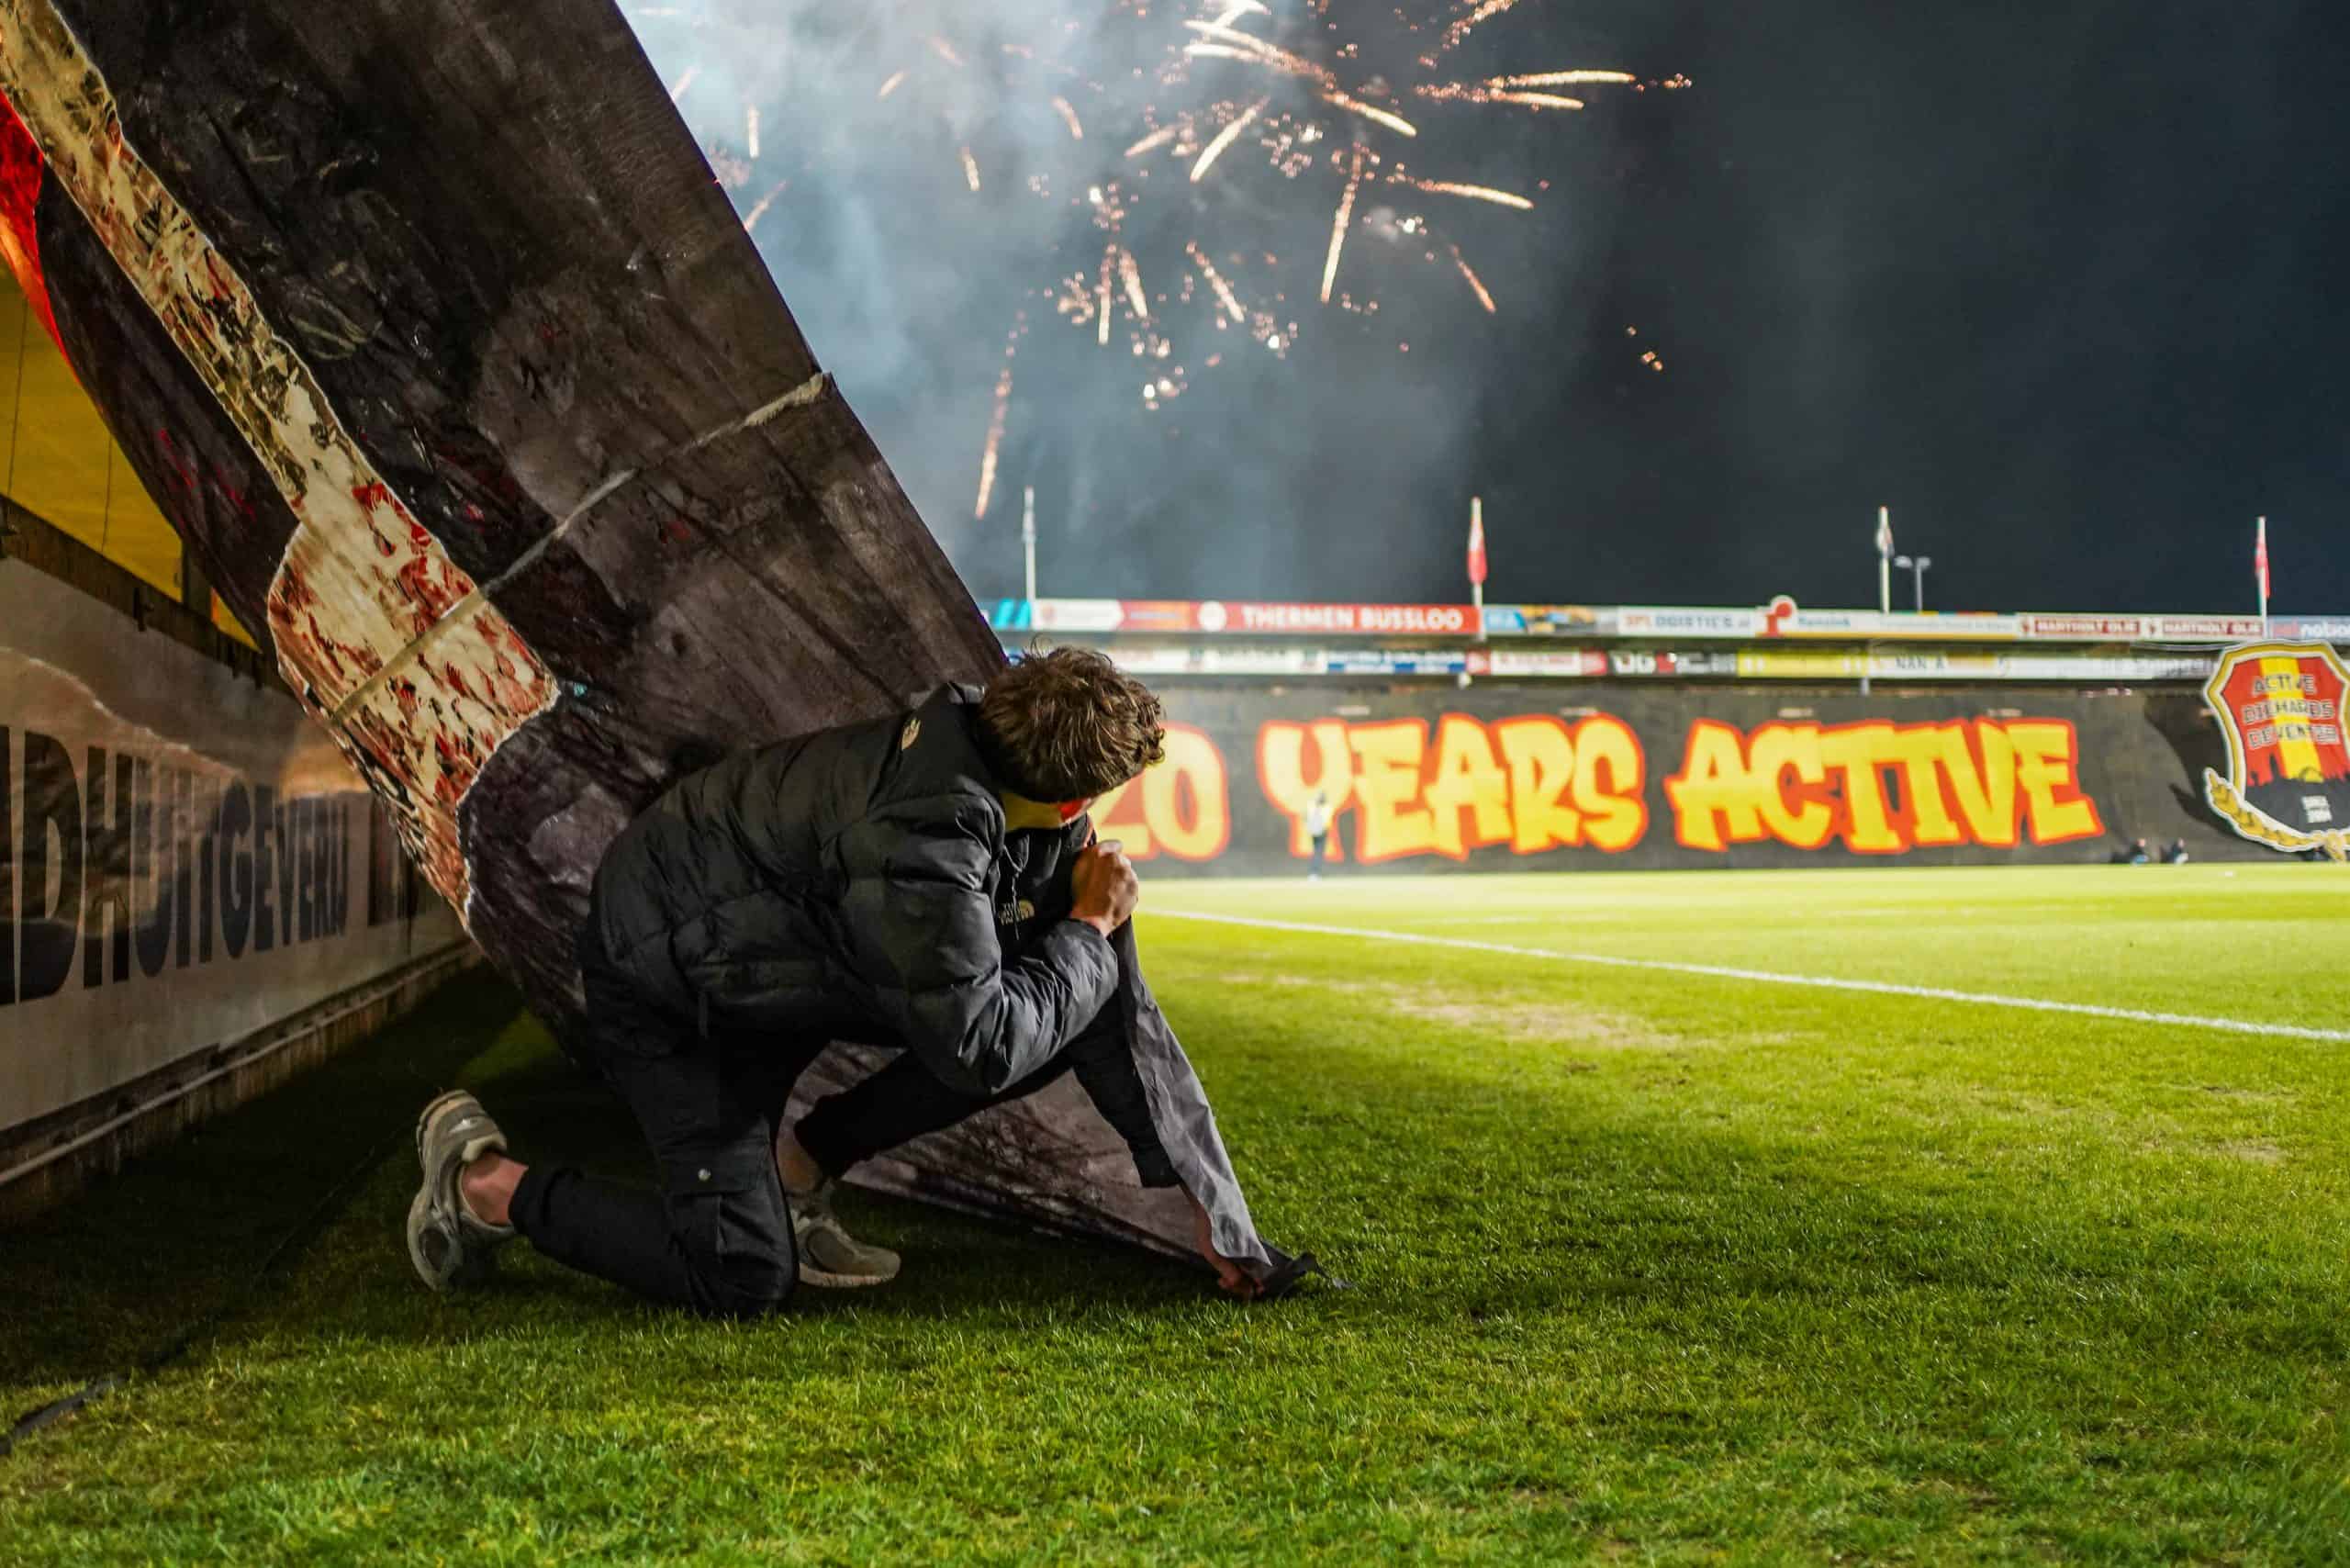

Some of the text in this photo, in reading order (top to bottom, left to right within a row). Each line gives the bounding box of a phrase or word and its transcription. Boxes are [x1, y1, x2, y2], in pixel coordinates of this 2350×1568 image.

[1243, 607, 1353, 629] THERMEN
[1360, 608, 1463, 630] BUSSLOO
[2252, 673, 2317, 695] ACTIVE
[1259, 713, 1647, 861] YEARS
[1665, 718, 2104, 854] ACTIVE
